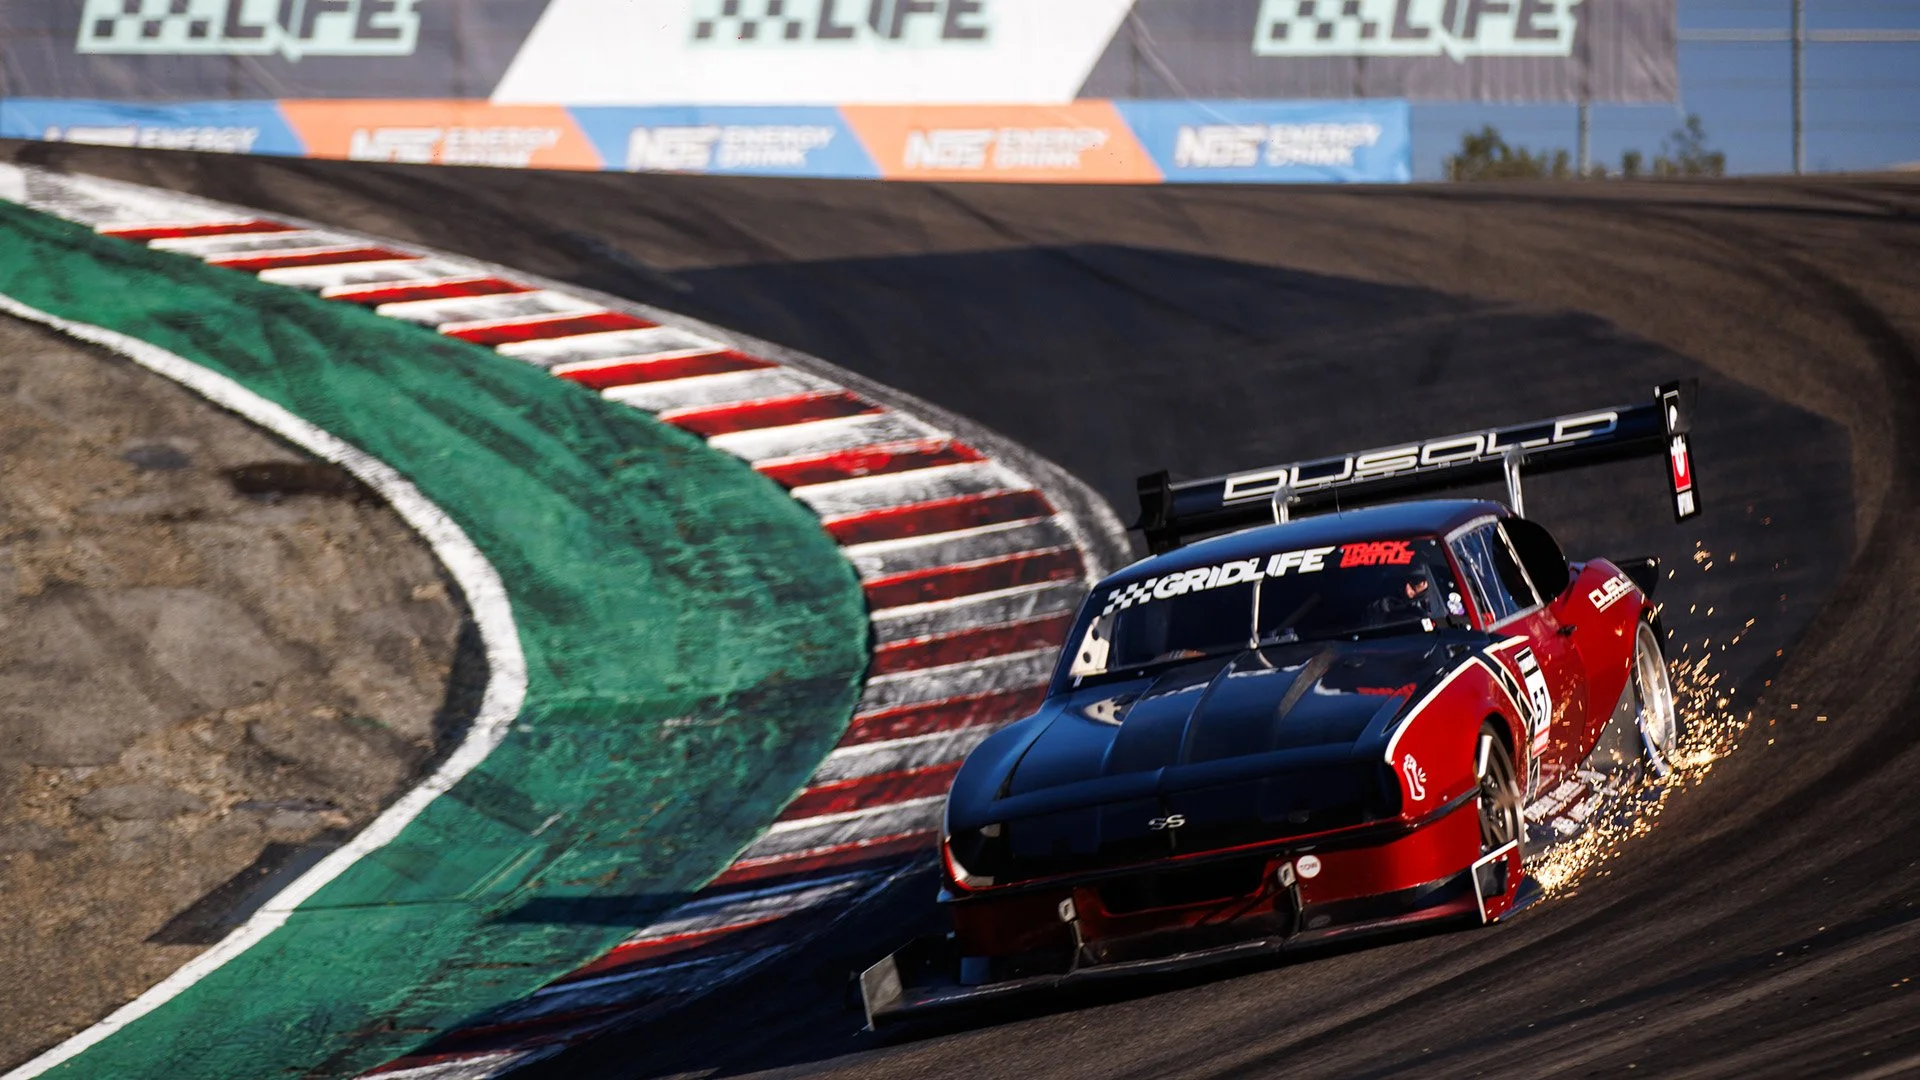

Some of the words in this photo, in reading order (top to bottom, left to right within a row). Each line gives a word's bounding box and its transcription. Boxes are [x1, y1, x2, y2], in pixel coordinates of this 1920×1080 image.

[445, 126, 562, 149] ENERGY
[719, 125, 836, 149] ENERGY
[996, 127, 1111, 150] ENERGY
[1175, 123, 1268, 168] NOS
[1266, 123, 1383, 148] ENERGY
[626, 125, 723, 171] NOS
[715, 147, 807, 168] DRINK
[903, 129, 995, 169] NOS
[992, 148, 1081, 169] DRINK
[1264, 145, 1354, 167] DRINK
[1223, 411, 1618, 500] DUSOLD
[1339, 551, 1416, 568] BATTLE
[1341, 541, 1411, 557] TRACK
[1153, 546, 1336, 599] GRIDLIFE
[1148, 814, 1186, 830] SS
